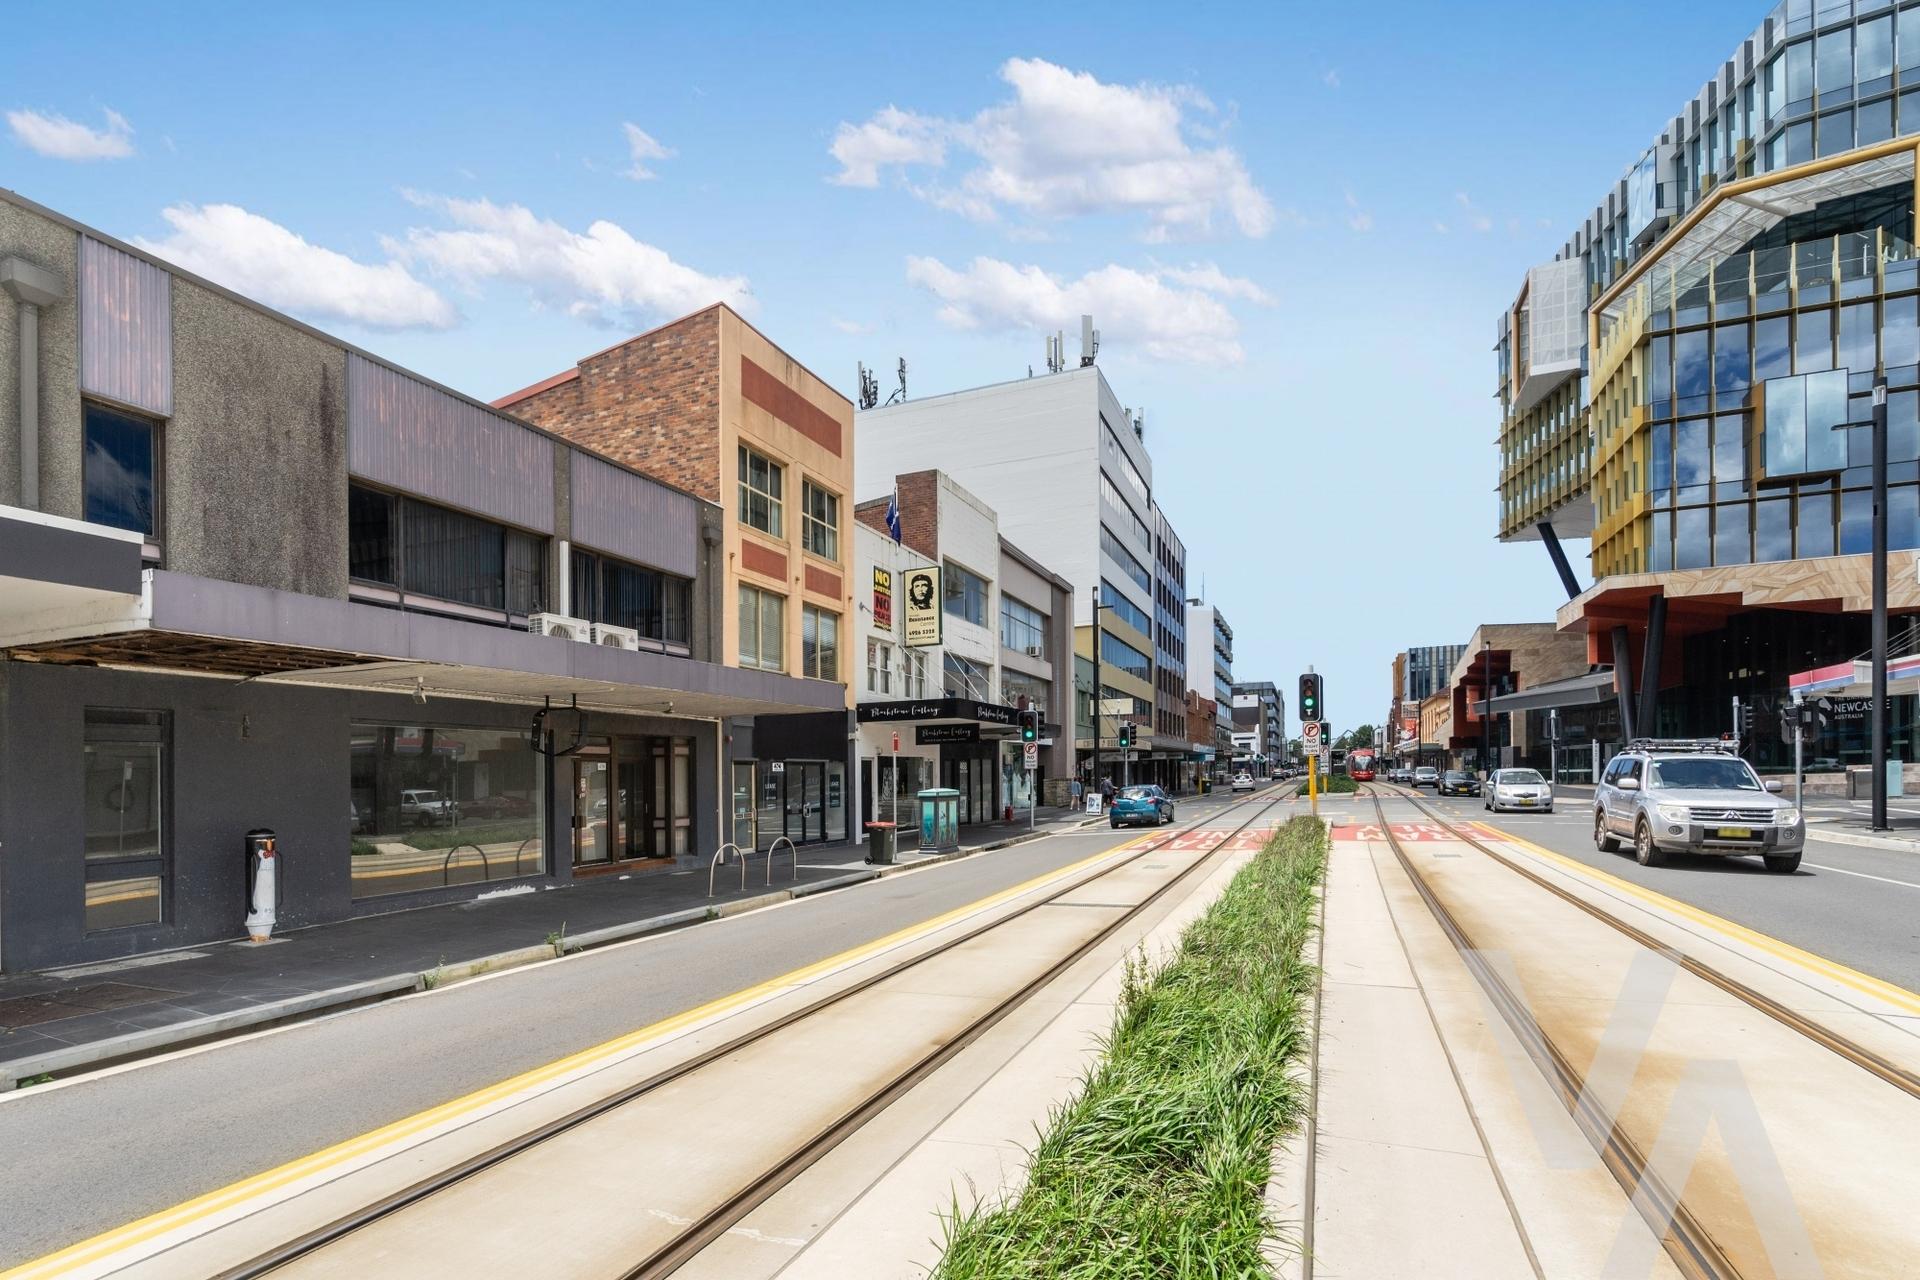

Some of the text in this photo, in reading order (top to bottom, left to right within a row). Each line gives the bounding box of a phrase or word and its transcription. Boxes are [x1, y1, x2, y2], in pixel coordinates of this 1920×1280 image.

[875, 569, 890, 588] NO
[875, 595, 890, 612] NO
[870, 704, 941, 718] Blackstone Gallery
[1833, 699, 1891, 713] NEWCAS
